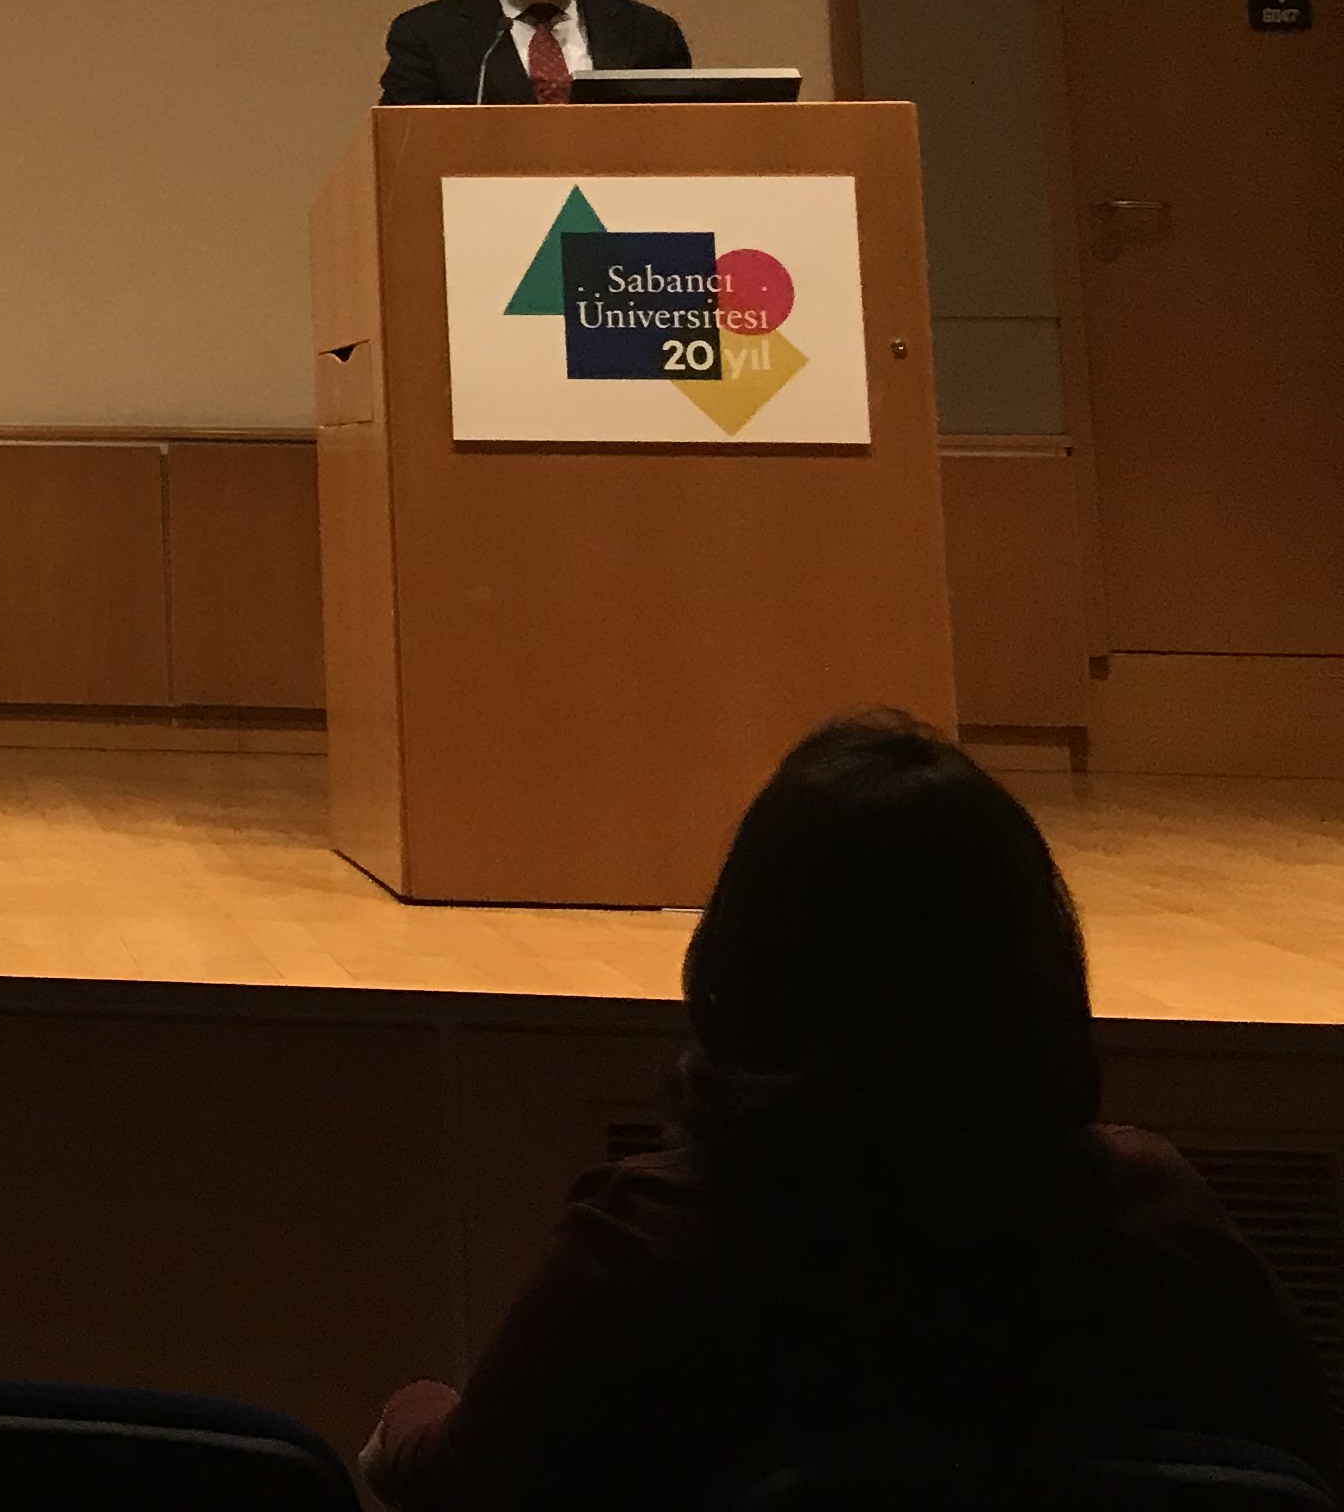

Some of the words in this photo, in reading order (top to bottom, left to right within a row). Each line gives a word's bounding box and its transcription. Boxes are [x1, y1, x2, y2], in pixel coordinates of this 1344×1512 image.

[607, 264, 734, 293] Sabancı
[662, 340, 714, 371] 20
[724, 338, 772, 380] yıl
